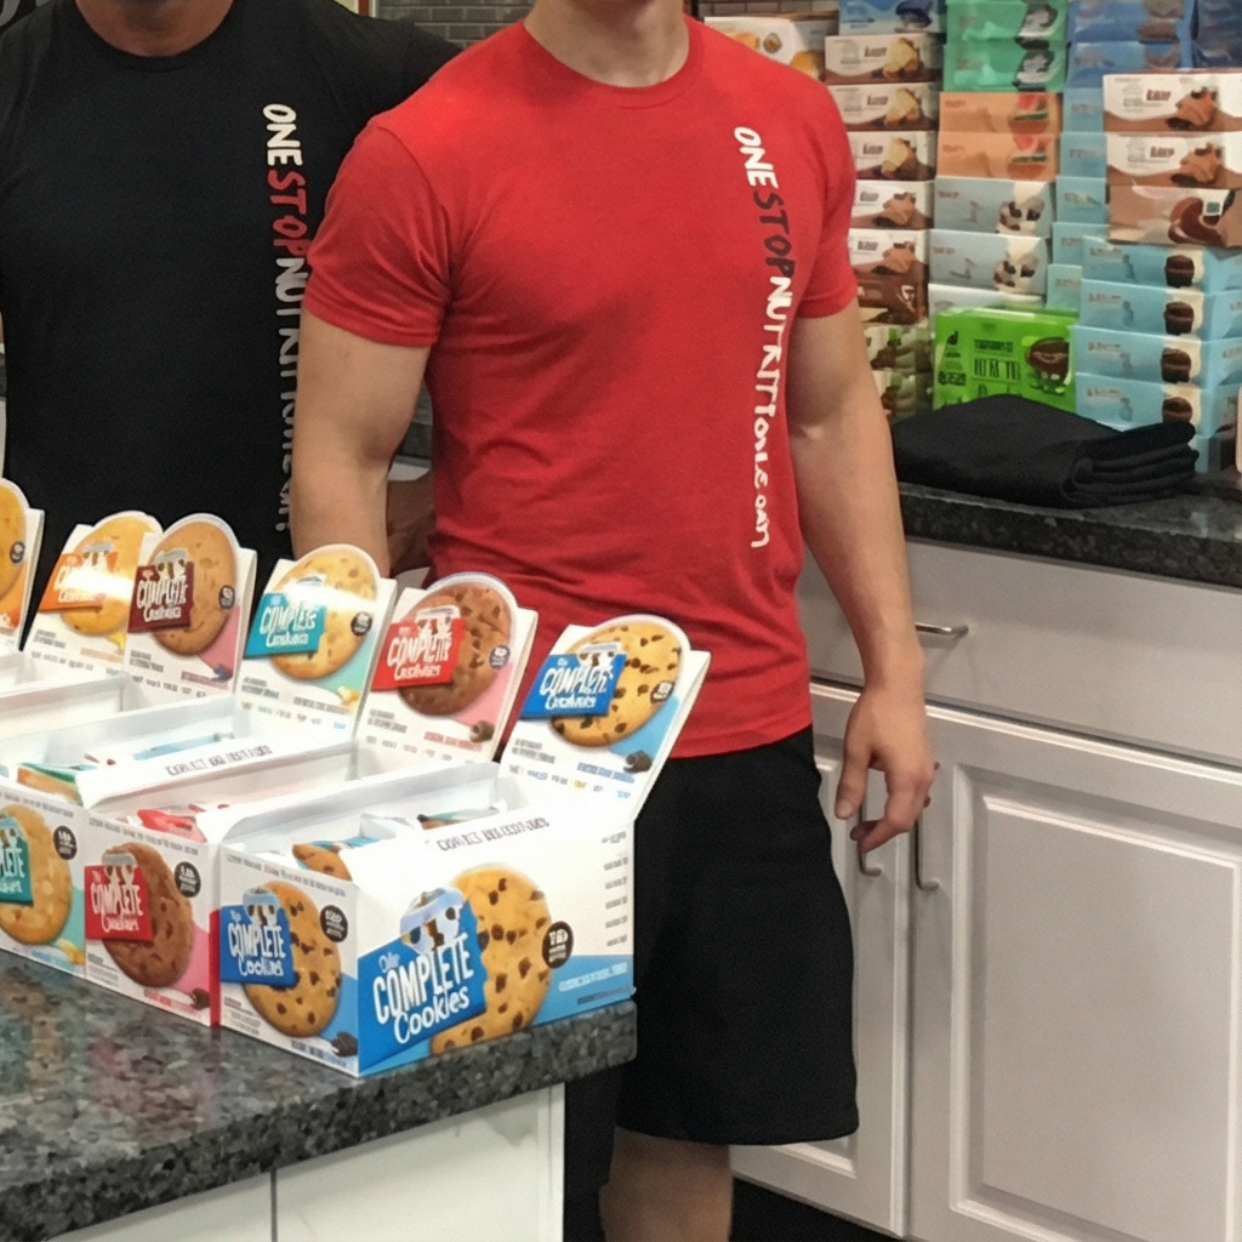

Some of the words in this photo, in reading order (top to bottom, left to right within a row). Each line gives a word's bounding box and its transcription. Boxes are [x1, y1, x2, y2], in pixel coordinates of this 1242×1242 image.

[227, 922, 287, 961] COMPLETE
[373, 931, 475, 1025] COMPLETE
[393, 985, 470, 1045] Cookies
